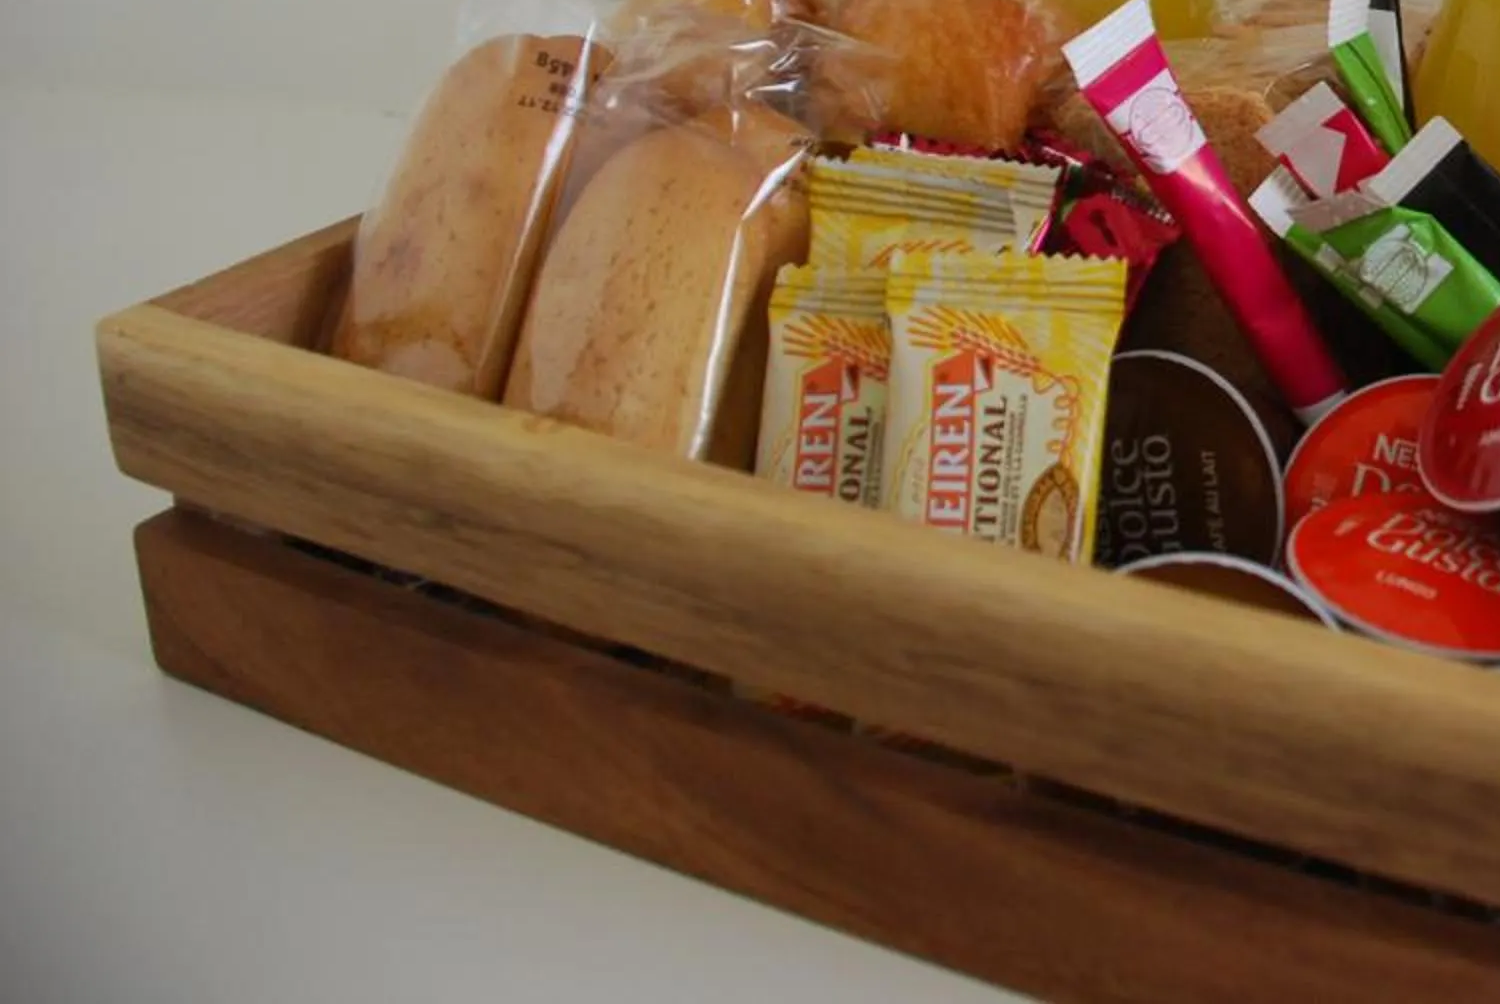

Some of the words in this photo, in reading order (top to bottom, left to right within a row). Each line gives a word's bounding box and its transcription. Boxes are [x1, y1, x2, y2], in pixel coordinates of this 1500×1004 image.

[797, 392, 839, 491] REN
[839, 406, 873, 503] ONAL
[929, 383, 973, 531] EIREN
